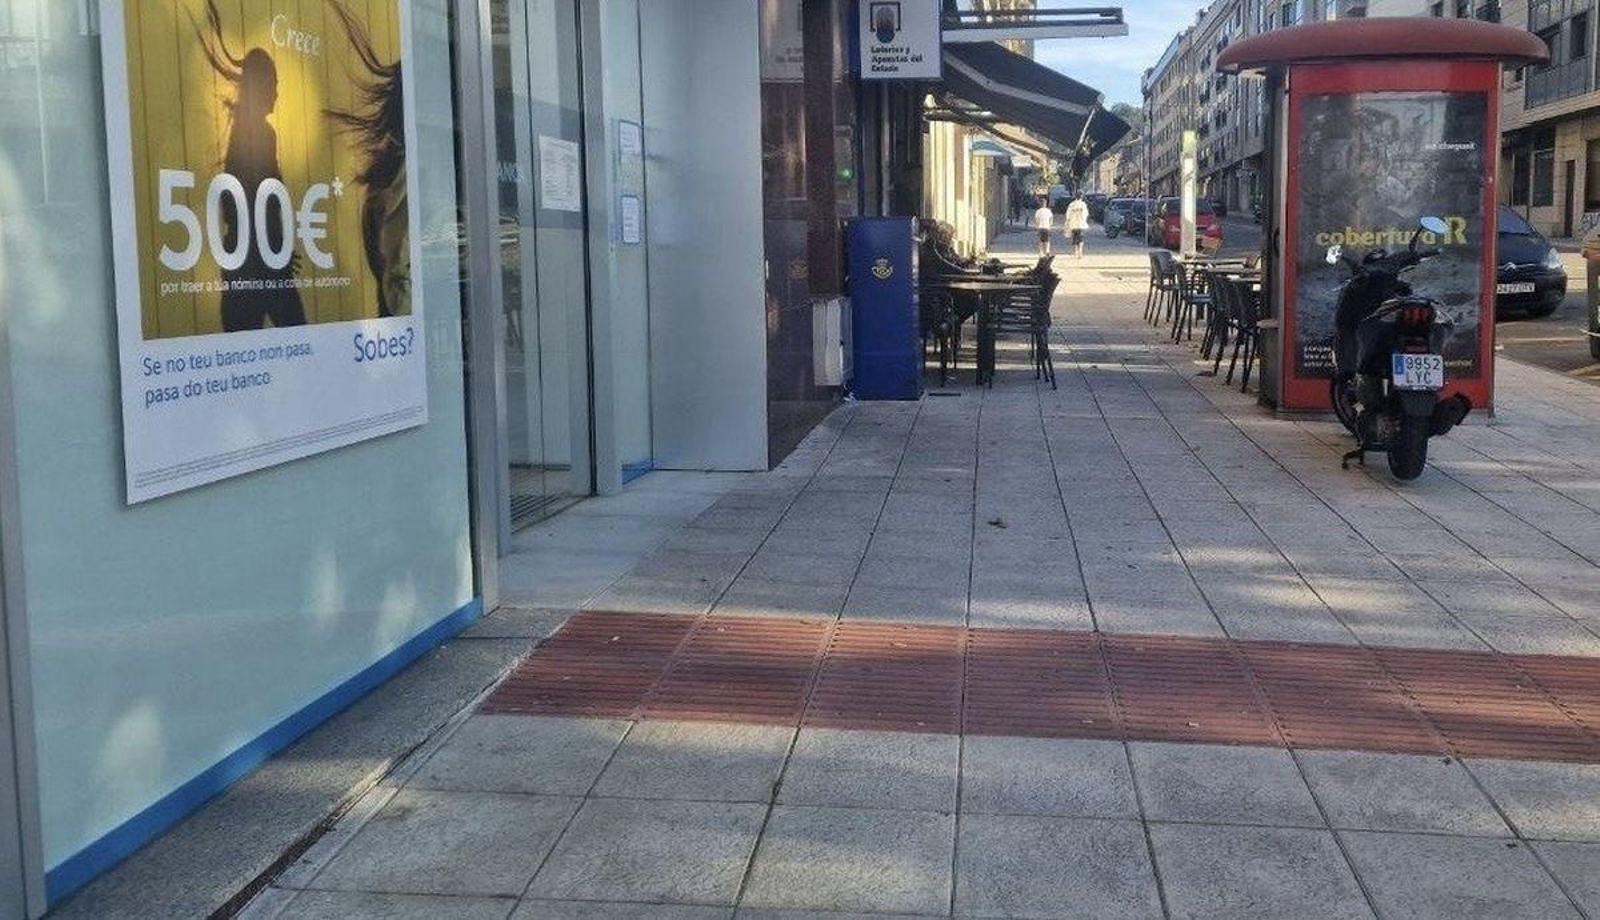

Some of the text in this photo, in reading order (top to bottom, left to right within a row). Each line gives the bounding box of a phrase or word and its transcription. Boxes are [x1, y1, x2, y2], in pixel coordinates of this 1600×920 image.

[271, 12, 320, 56] Crece
[161, 282, 179, 297] por
[181, 279, 203, 293] traer
[231, 276, 263, 291] nómina
[143, 357, 161, 376] Se
[166, 356, 186, 373] no
[190, 352, 213, 370] teu
[216, 348, 256, 366] banco
[259, 345, 284, 360] non
[353, 327, 415, 364] Sobes?
[1405, 356, 1440, 370] 9952
[1406, 371, 1432, 384] LYC
[145, 371, 271, 408] pasa do teu banco
